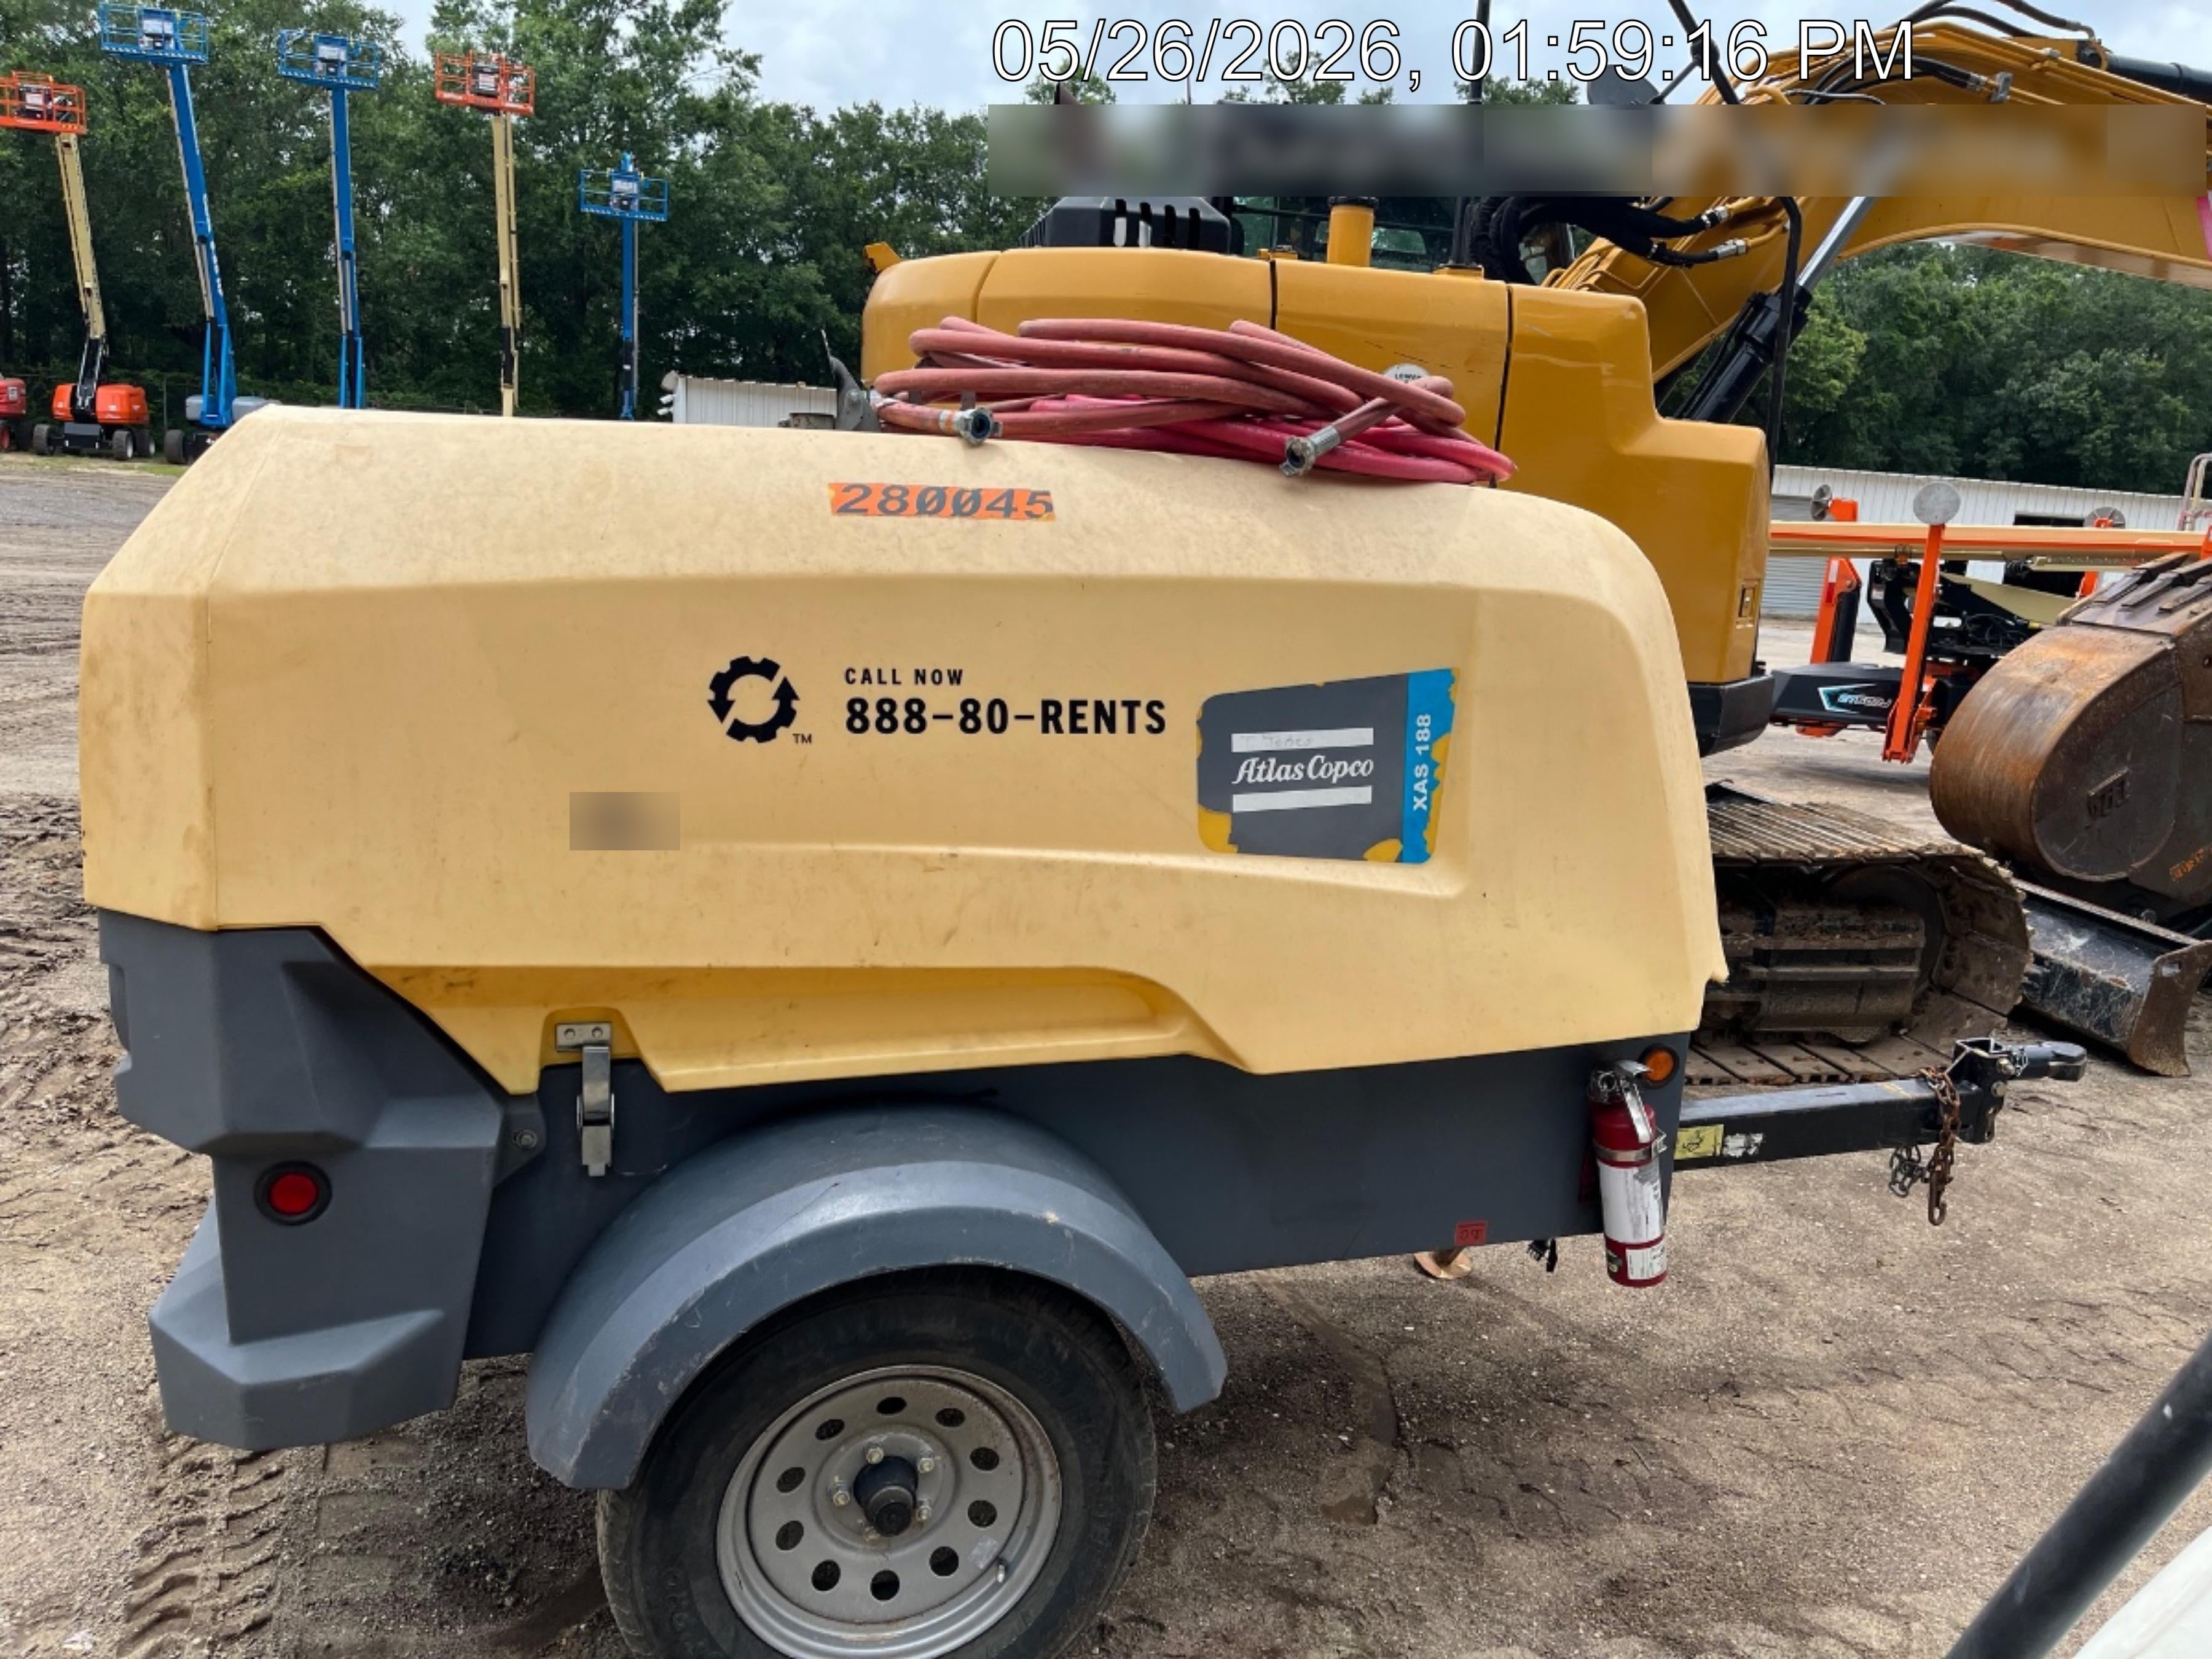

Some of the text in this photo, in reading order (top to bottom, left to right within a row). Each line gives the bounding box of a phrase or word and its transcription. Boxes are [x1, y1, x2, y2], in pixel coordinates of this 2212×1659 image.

[836, 484, 1054, 519] 280045
[844, 668, 963, 686] CALL NOW
[845, 697, 1166, 735] 888-80-RENTS
[792, 733, 812, 744] TM
[1231, 755, 1374, 784] Atlas Copco
[1413, 714, 1431, 811] XAS 188
